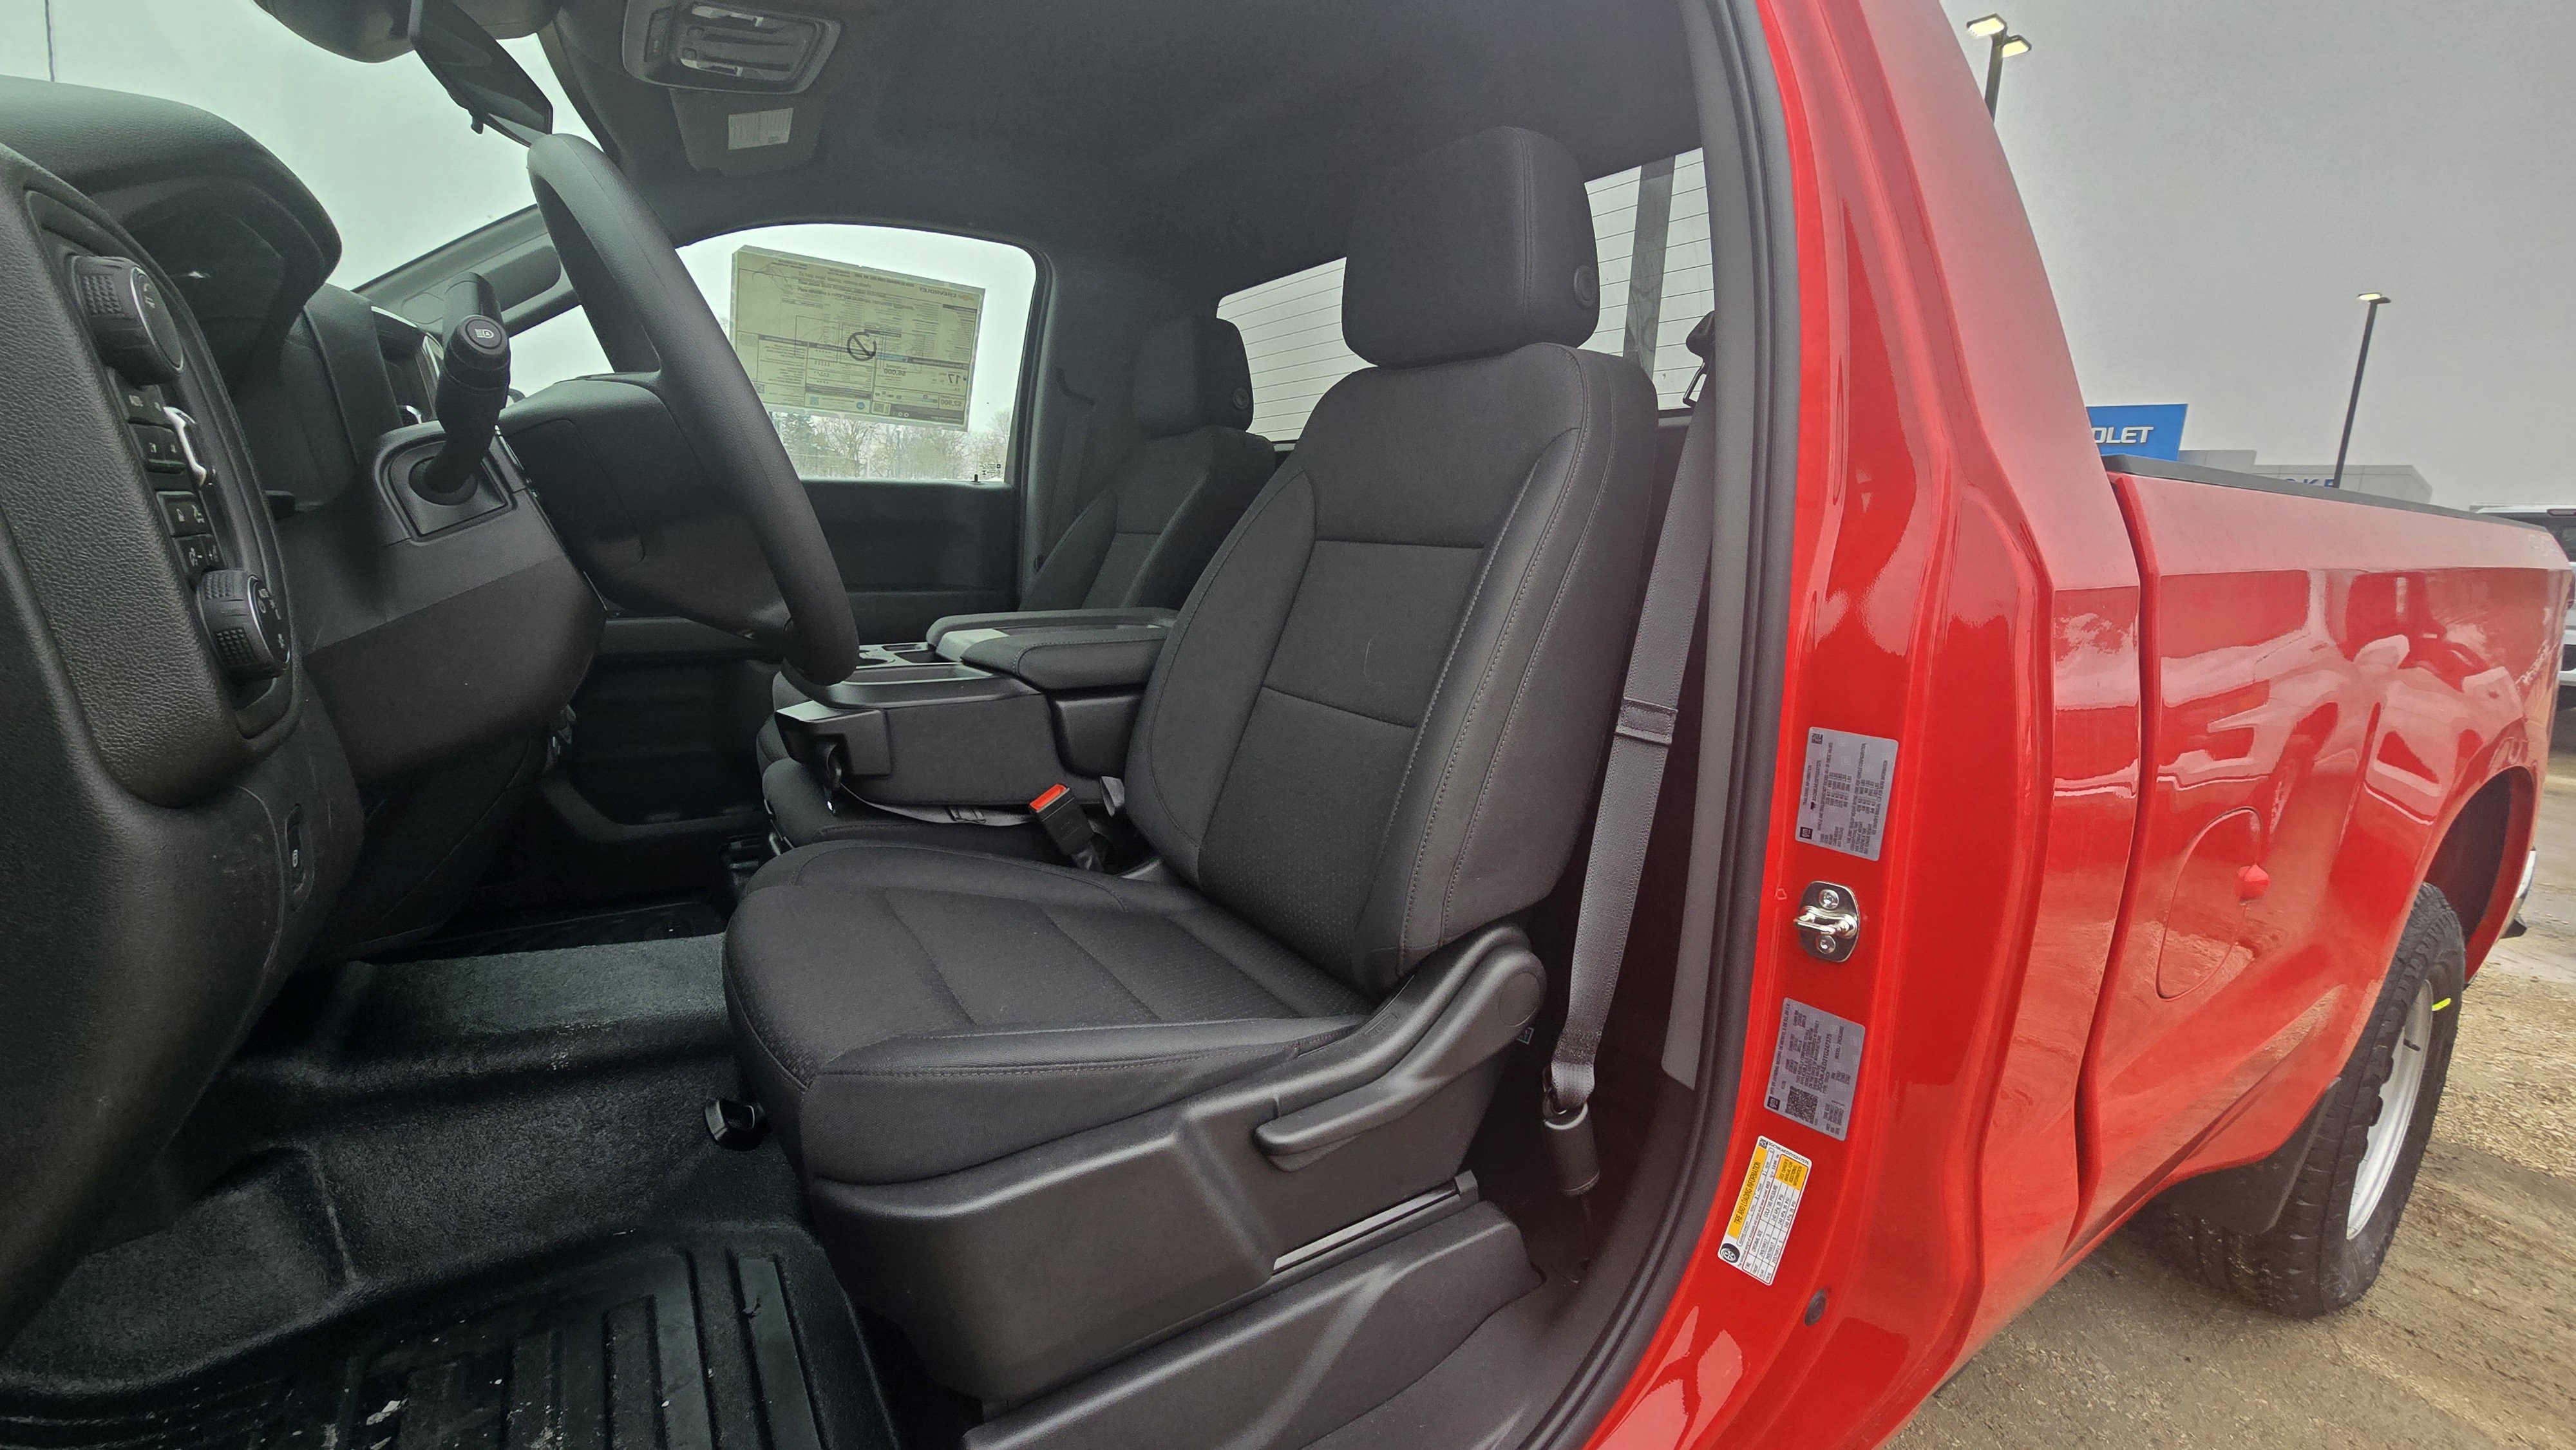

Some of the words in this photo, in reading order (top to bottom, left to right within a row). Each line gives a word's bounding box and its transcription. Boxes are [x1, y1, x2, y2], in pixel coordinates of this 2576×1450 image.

[1734, 1214, 1742, 1225] TIRE
[1740, 1187, 1752, 1207] LOADING
[1747, 1160, 1761, 1189] INFORMATION
